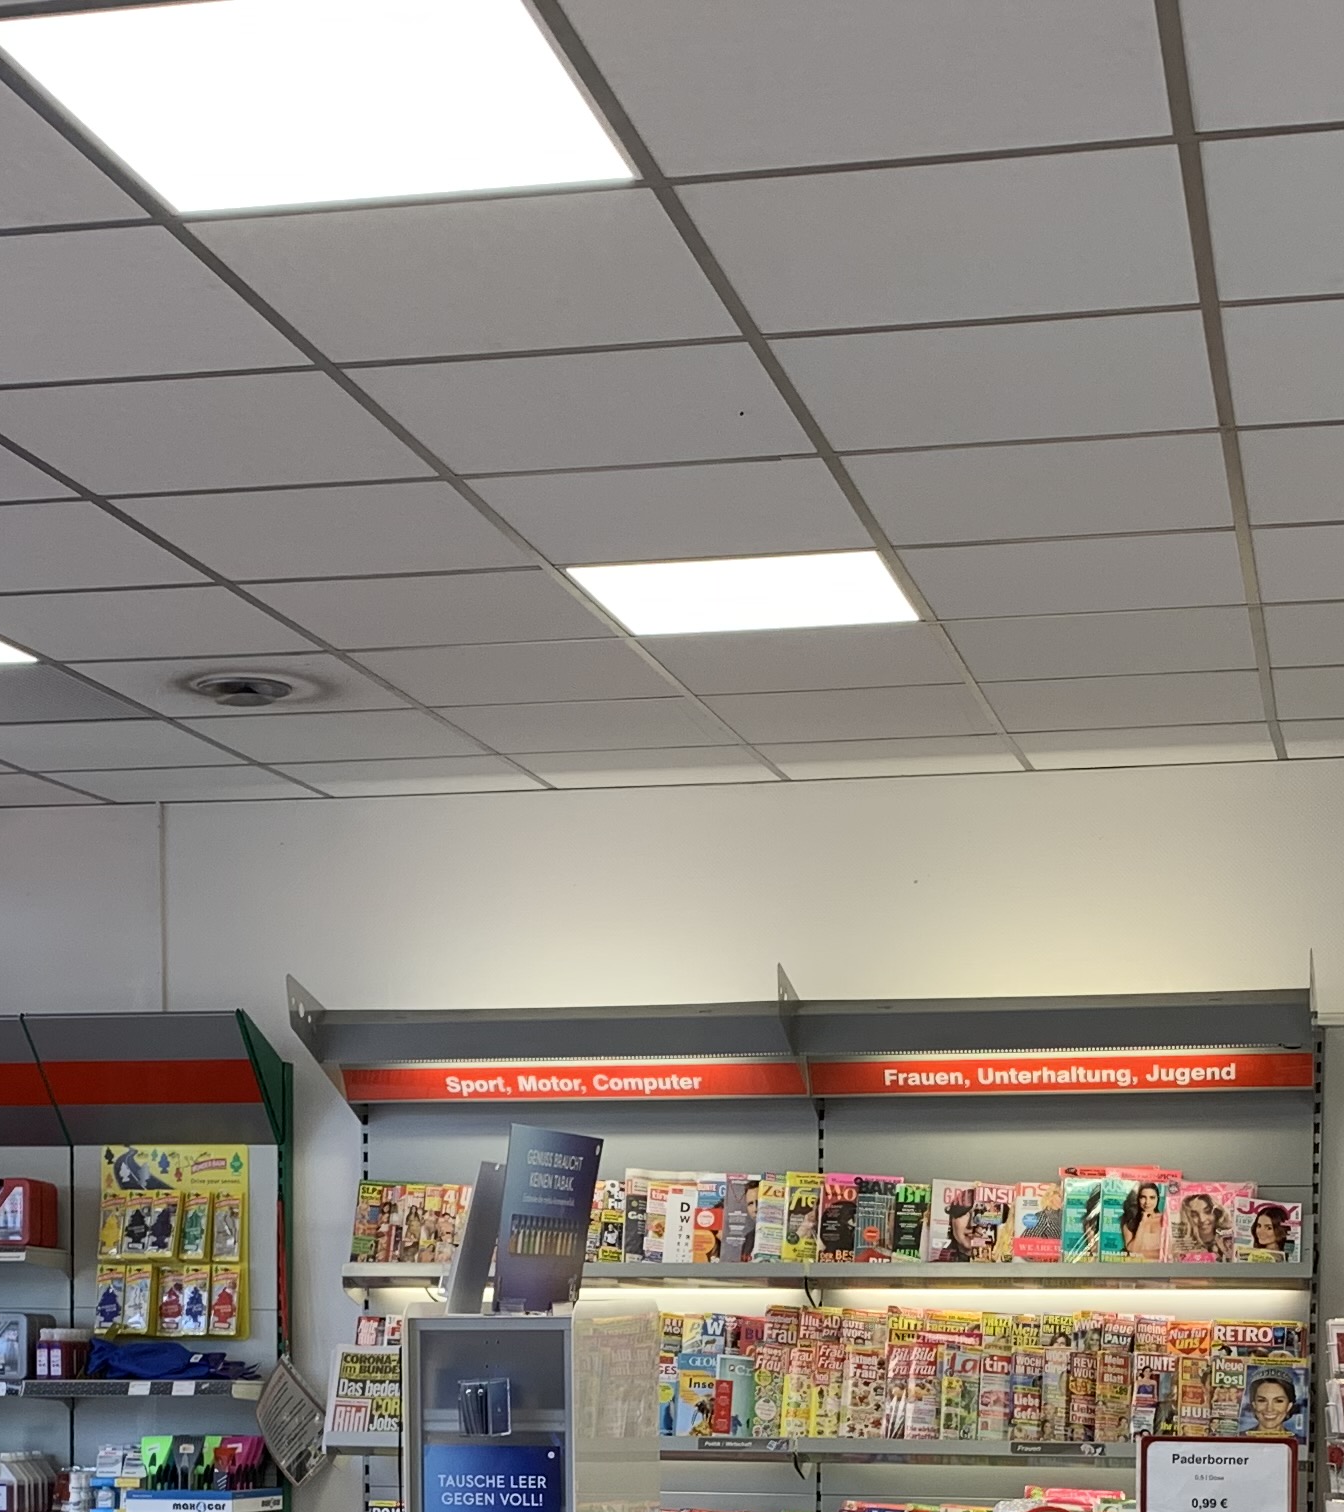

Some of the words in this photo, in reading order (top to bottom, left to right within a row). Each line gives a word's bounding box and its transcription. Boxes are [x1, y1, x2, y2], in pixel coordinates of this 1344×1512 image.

[884, 1069, 970, 1087] Frauen,
[978, 1066, 1138, 1086] Unterhaltung,
[1145, 1064, 1236, 1084] Jugend
[446, 1076, 512, 1095] Sport,
[518, 1075, 587, 1094] Motor,
[593, 1074, 702, 1093] Computer
[527, 1149, 552, 1167] GENUSS
[554, 1153, 584, 1172] BRAUCHT
[529, 1172, 553, 1189] KEINEN
[764, 1323, 797, 1344] Frau
[1137, 1323, 1166, 1335] meine
[1169, 1328, 1189, 1340] Nur
[1191, 1328, 1206, 1339] für
[1213, 1326, 1272, 1342] RETRO
[1174, 1338, 1200, 1349] uns
[1137, 1356, 1175, 1371] BUNTE
[1215, 1358, 1243, 1371] Neue
[1215, 1372, 1243, 1387] Post
[1016, 1444, 1042, 1453] Frauen
[1172, 1454, 1249, 1465] Paderborner
[438, 1475, 505, 1488] TAUSCHE
[510, 1475, 547, 1488] LEER
[441, 1492, 495, 1506] GEGEN
[499, 1493, 543, 1507] VOLL!
[1191, 1498, 1217, 1509] 0,99
[1220, 1498, 1228, 1508] €
